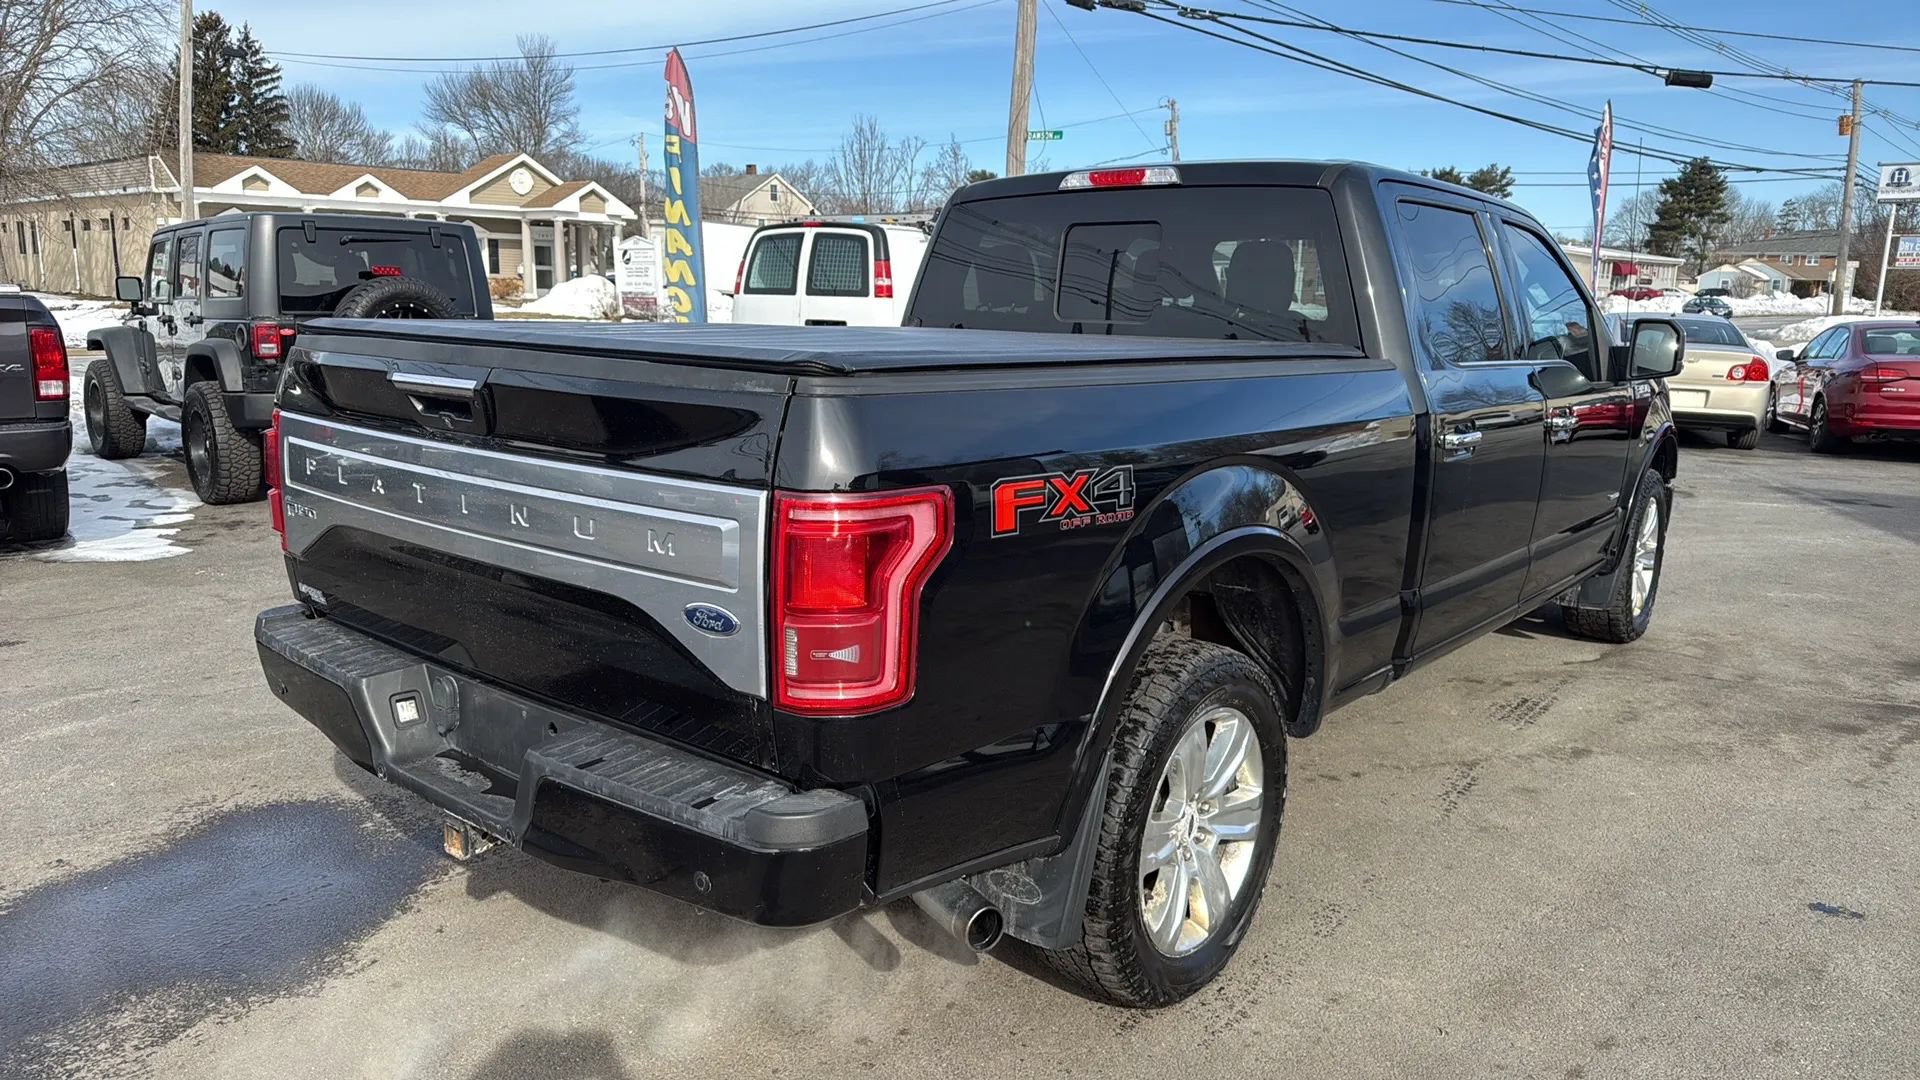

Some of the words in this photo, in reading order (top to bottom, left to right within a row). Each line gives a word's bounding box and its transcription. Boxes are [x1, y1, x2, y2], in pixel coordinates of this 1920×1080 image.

[1893, 170, 1908, 183] H
[306, 457, 676, 557] PLATINUM
[990, 464, 1136, 539] FX4
[1060, 515, 1091, 530] OFF
[1096, 510, 1135, 525] ROAD
[693, 608, 725, 631] Ford
